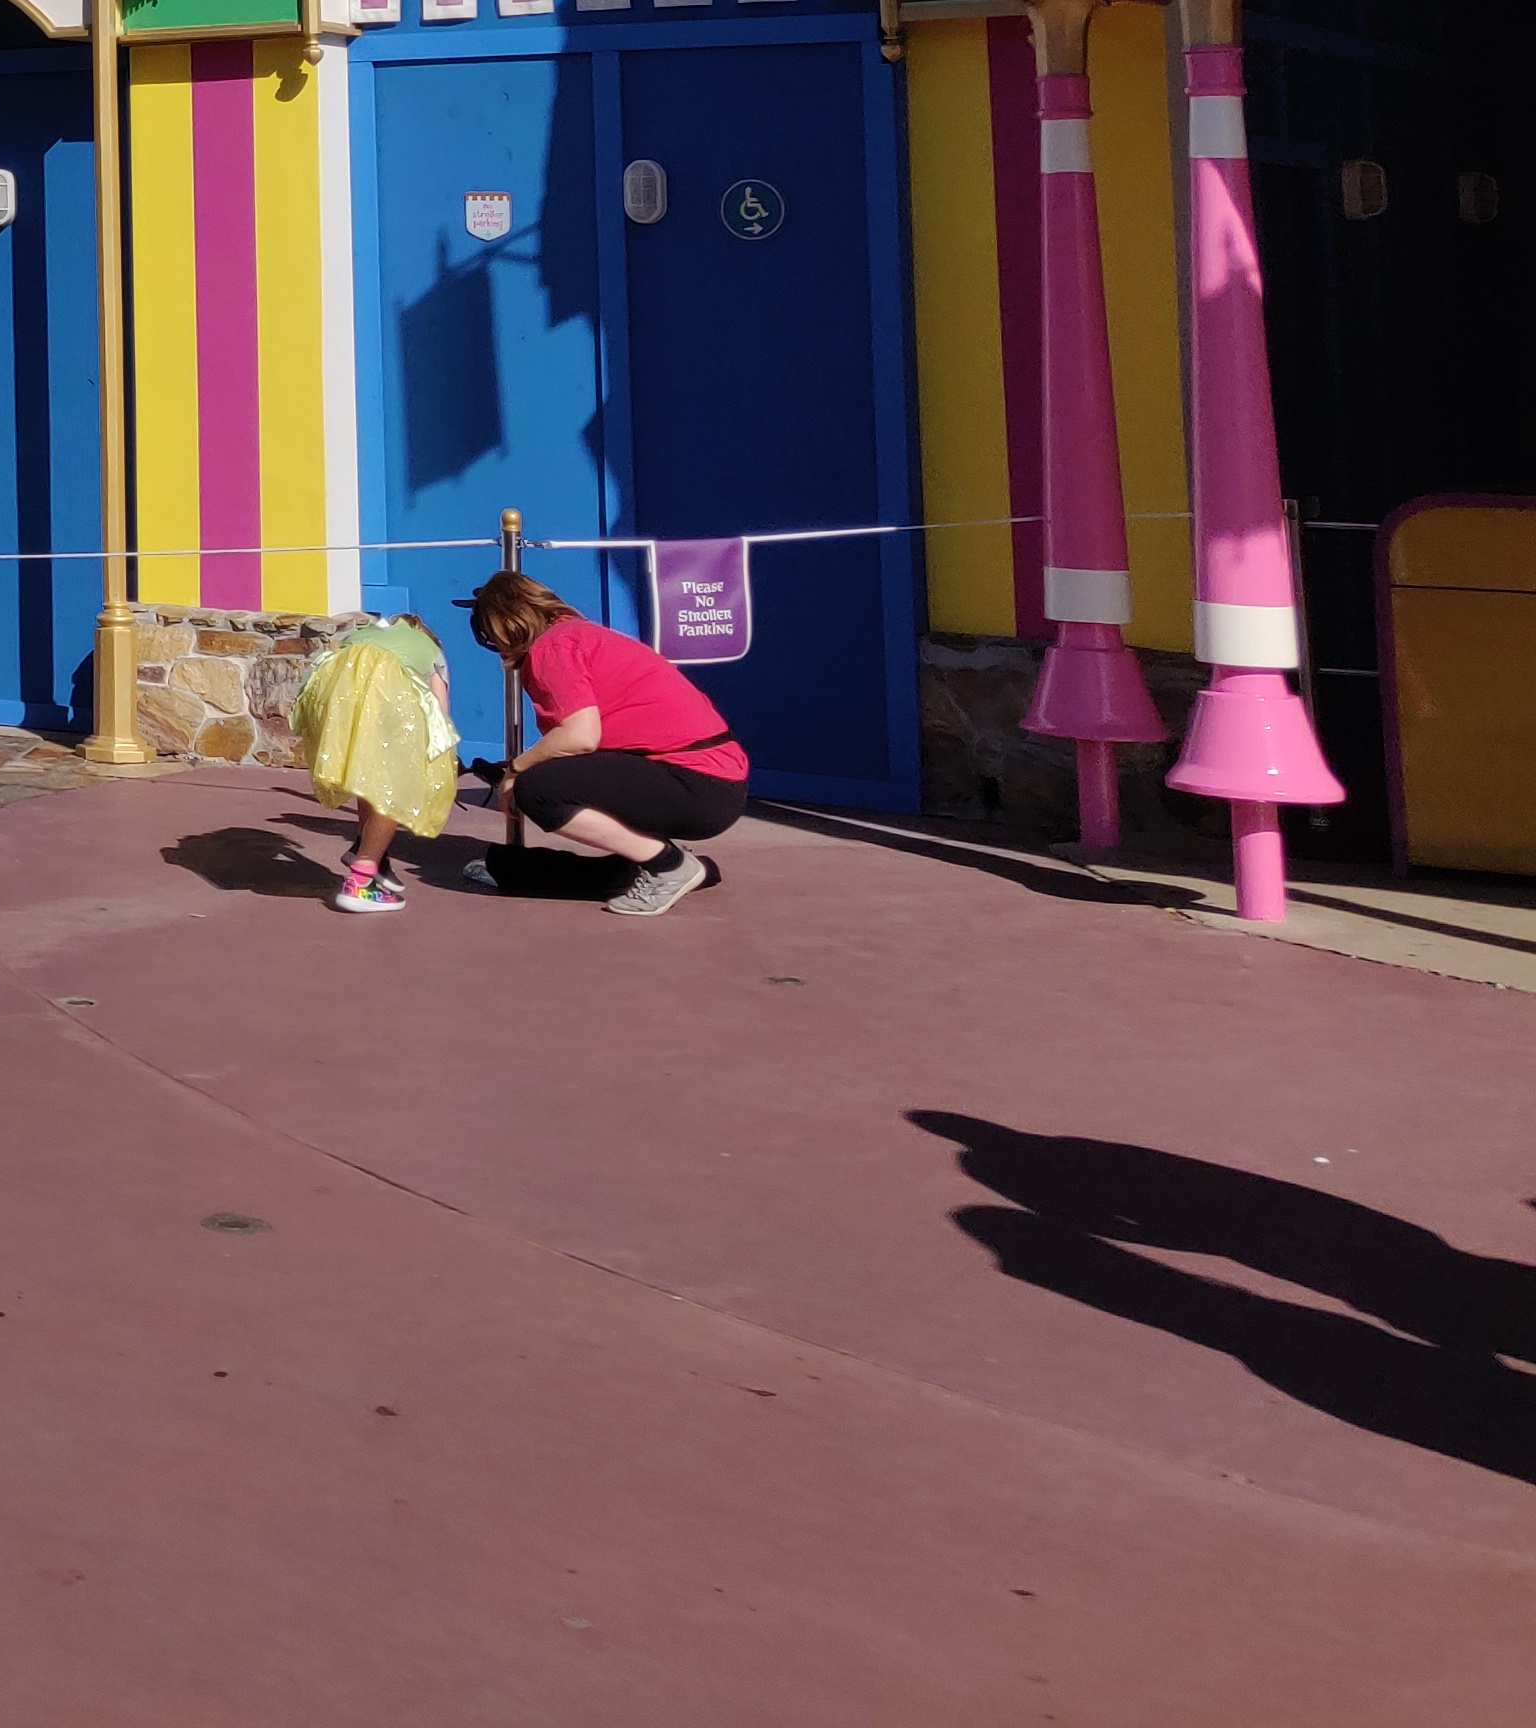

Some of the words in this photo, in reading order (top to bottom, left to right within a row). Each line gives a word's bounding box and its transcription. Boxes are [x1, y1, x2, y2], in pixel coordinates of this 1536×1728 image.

[681, 581, 725, 594] Please
[694, 595, 715, 608] No
[678, 609, 733, 622] Stroller
[678, 622, 734, 637] Parking
